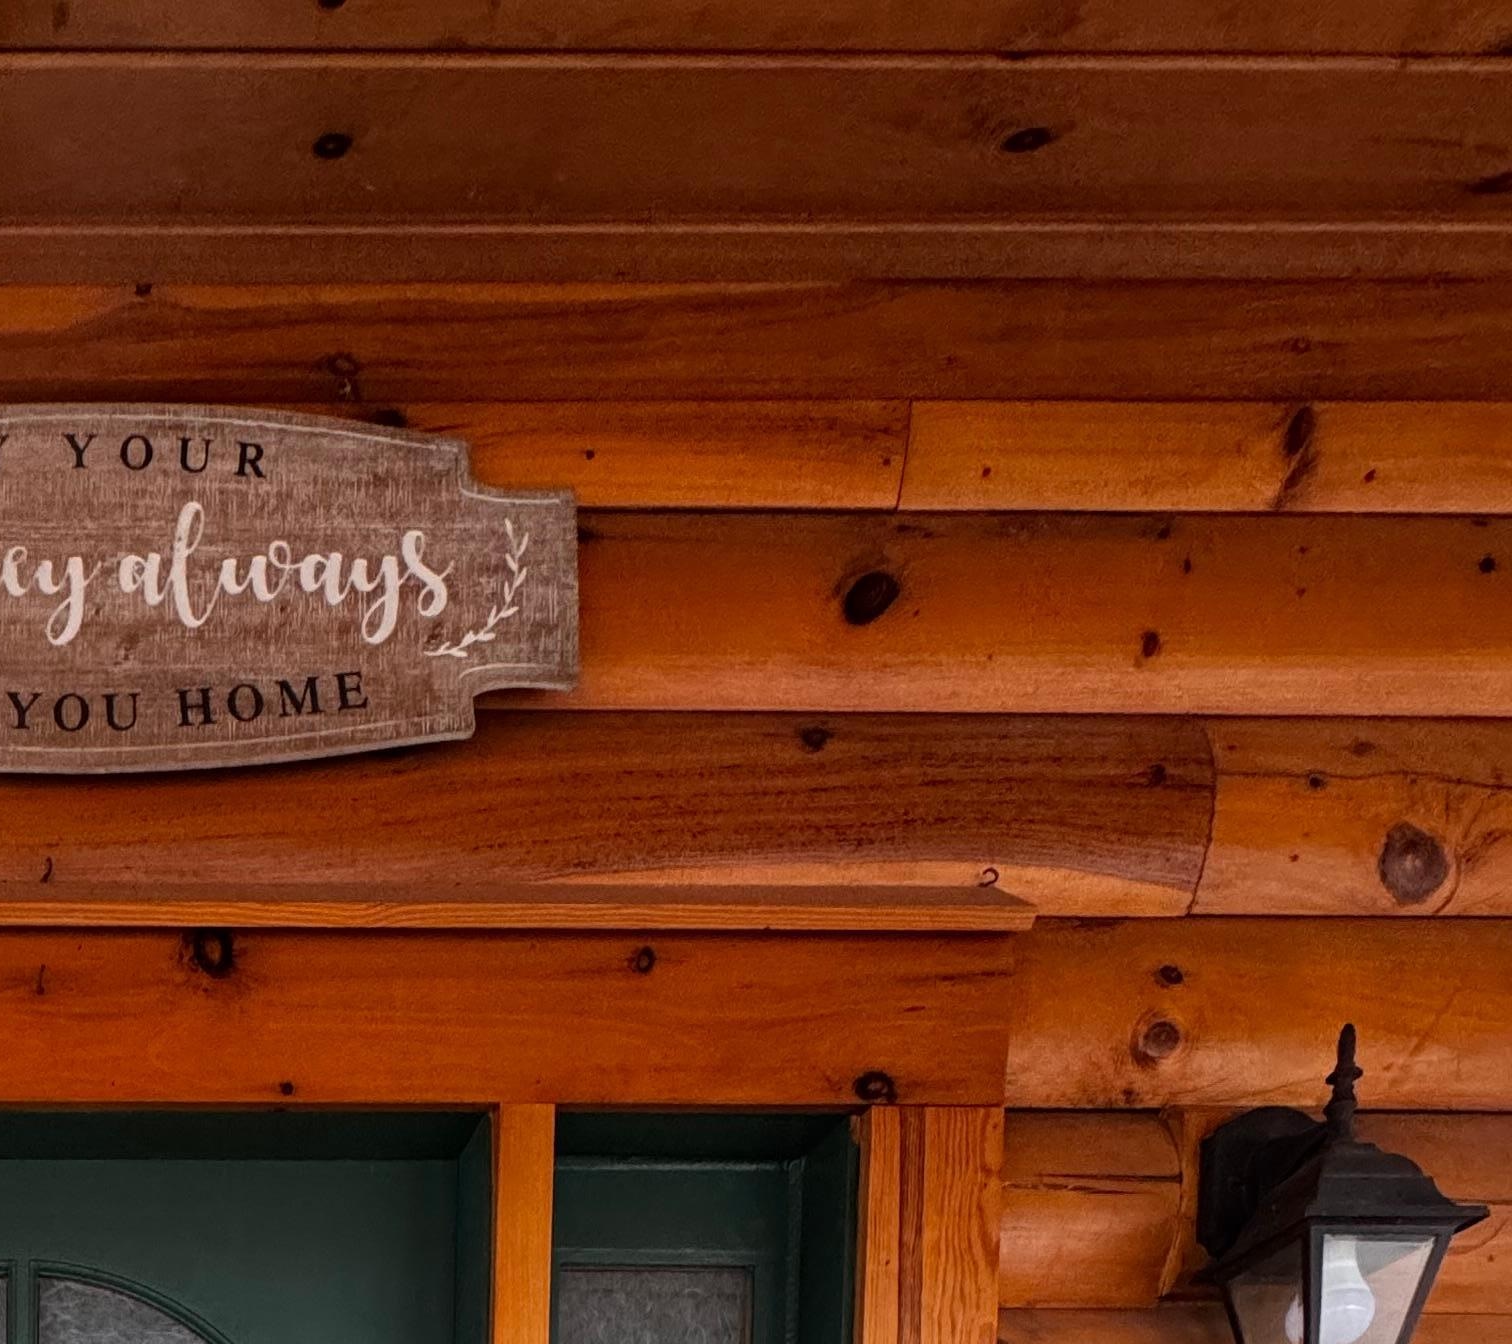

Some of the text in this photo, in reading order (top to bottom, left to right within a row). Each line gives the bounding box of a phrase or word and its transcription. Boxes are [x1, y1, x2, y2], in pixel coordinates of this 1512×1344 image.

[61, 432, 269, 478] YOUR
[118, 500, 455, 645] always
[6, 691, 141, 732] YOU
[177, 670, 369, 727] HOME
